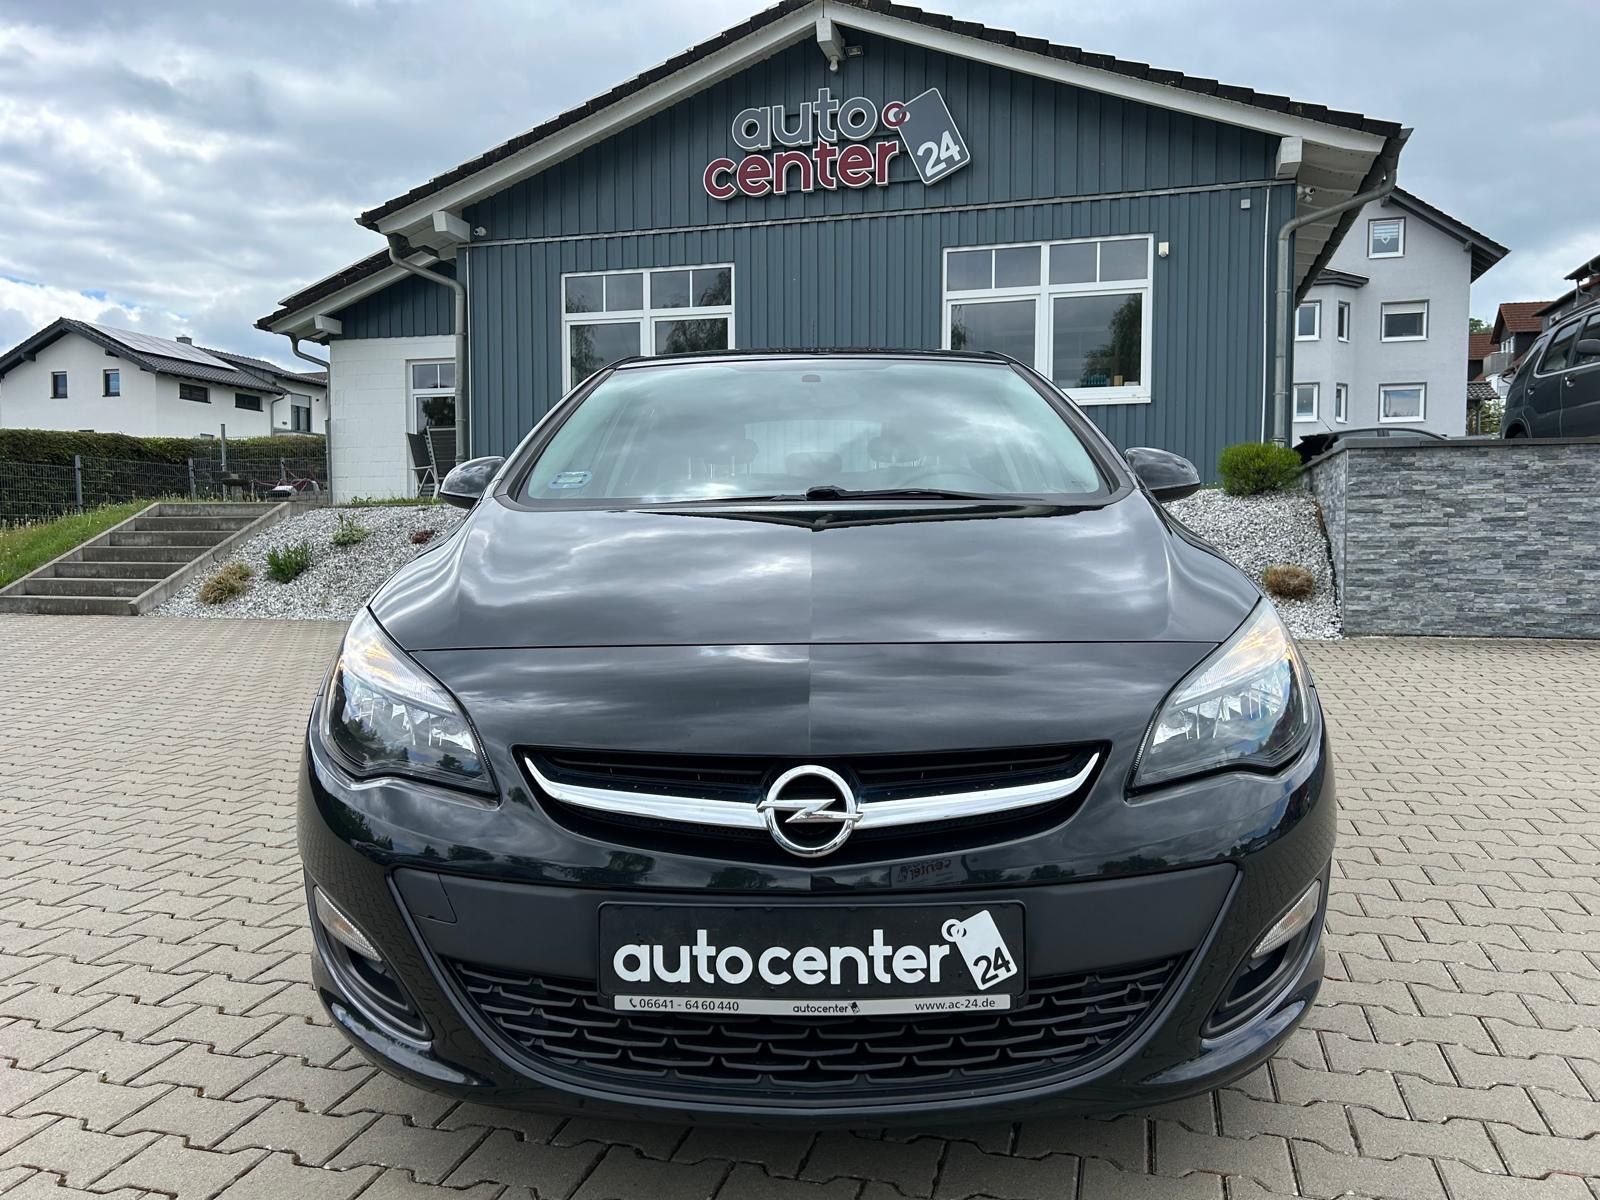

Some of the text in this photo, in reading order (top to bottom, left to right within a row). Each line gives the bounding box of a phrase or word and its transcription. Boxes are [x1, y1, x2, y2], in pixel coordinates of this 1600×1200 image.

[731, 87, 878, 150] auto
[703, 136, 899, 200] center
[917, 130, 961, 177] 24
[972, 946, 1012, 986] 24
[639, 998, 674, 1009] 06641
[792, 1003, 848, 1013] autocenter
[915, 998, 996, 1011] www.ac-24.de
